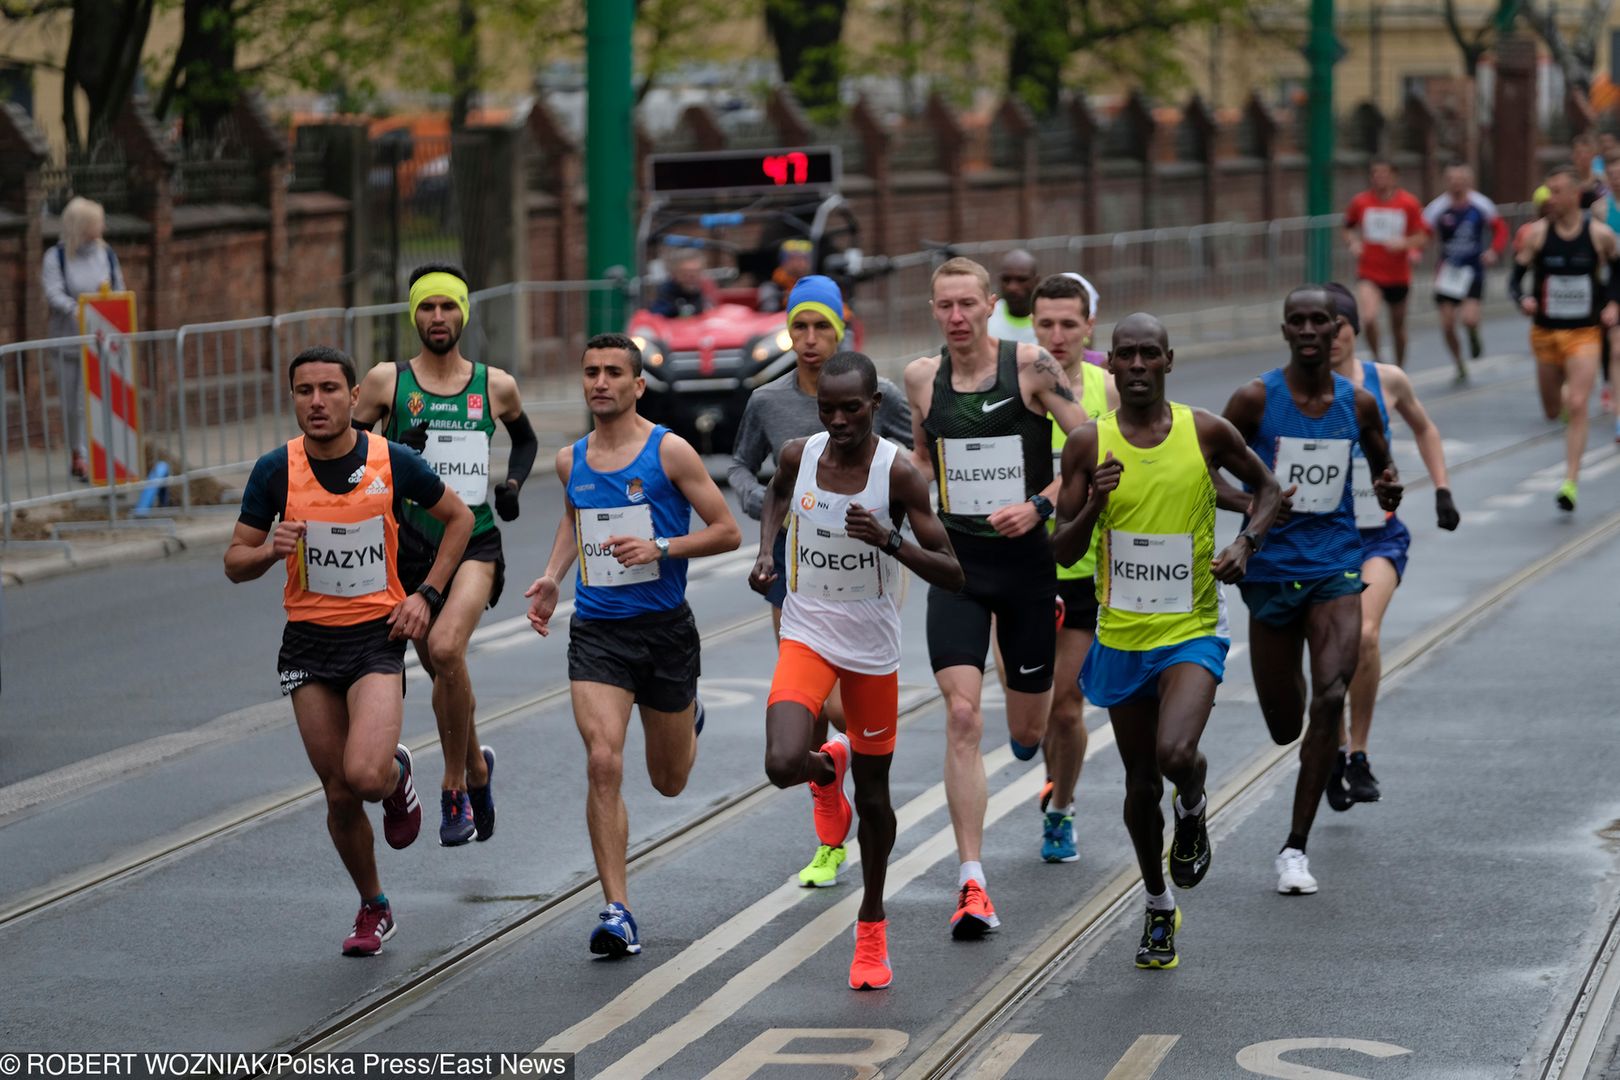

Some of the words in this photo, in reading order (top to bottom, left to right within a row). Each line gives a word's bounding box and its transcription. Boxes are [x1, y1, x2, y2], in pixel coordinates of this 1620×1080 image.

[431, 462, 487, 475] HEMLAL
[947, 466, 1022, 481] ZALEWSKI
[1288, 464, 1339, 485] ROP
[817, 501, 830, 510] NN
[308, 543, 384, 569] RAZYN
[584, 543, 612, 557] OUB
[800, 545, 875, 571] KOECH
[1114, 560, 1189, 580] KERING
